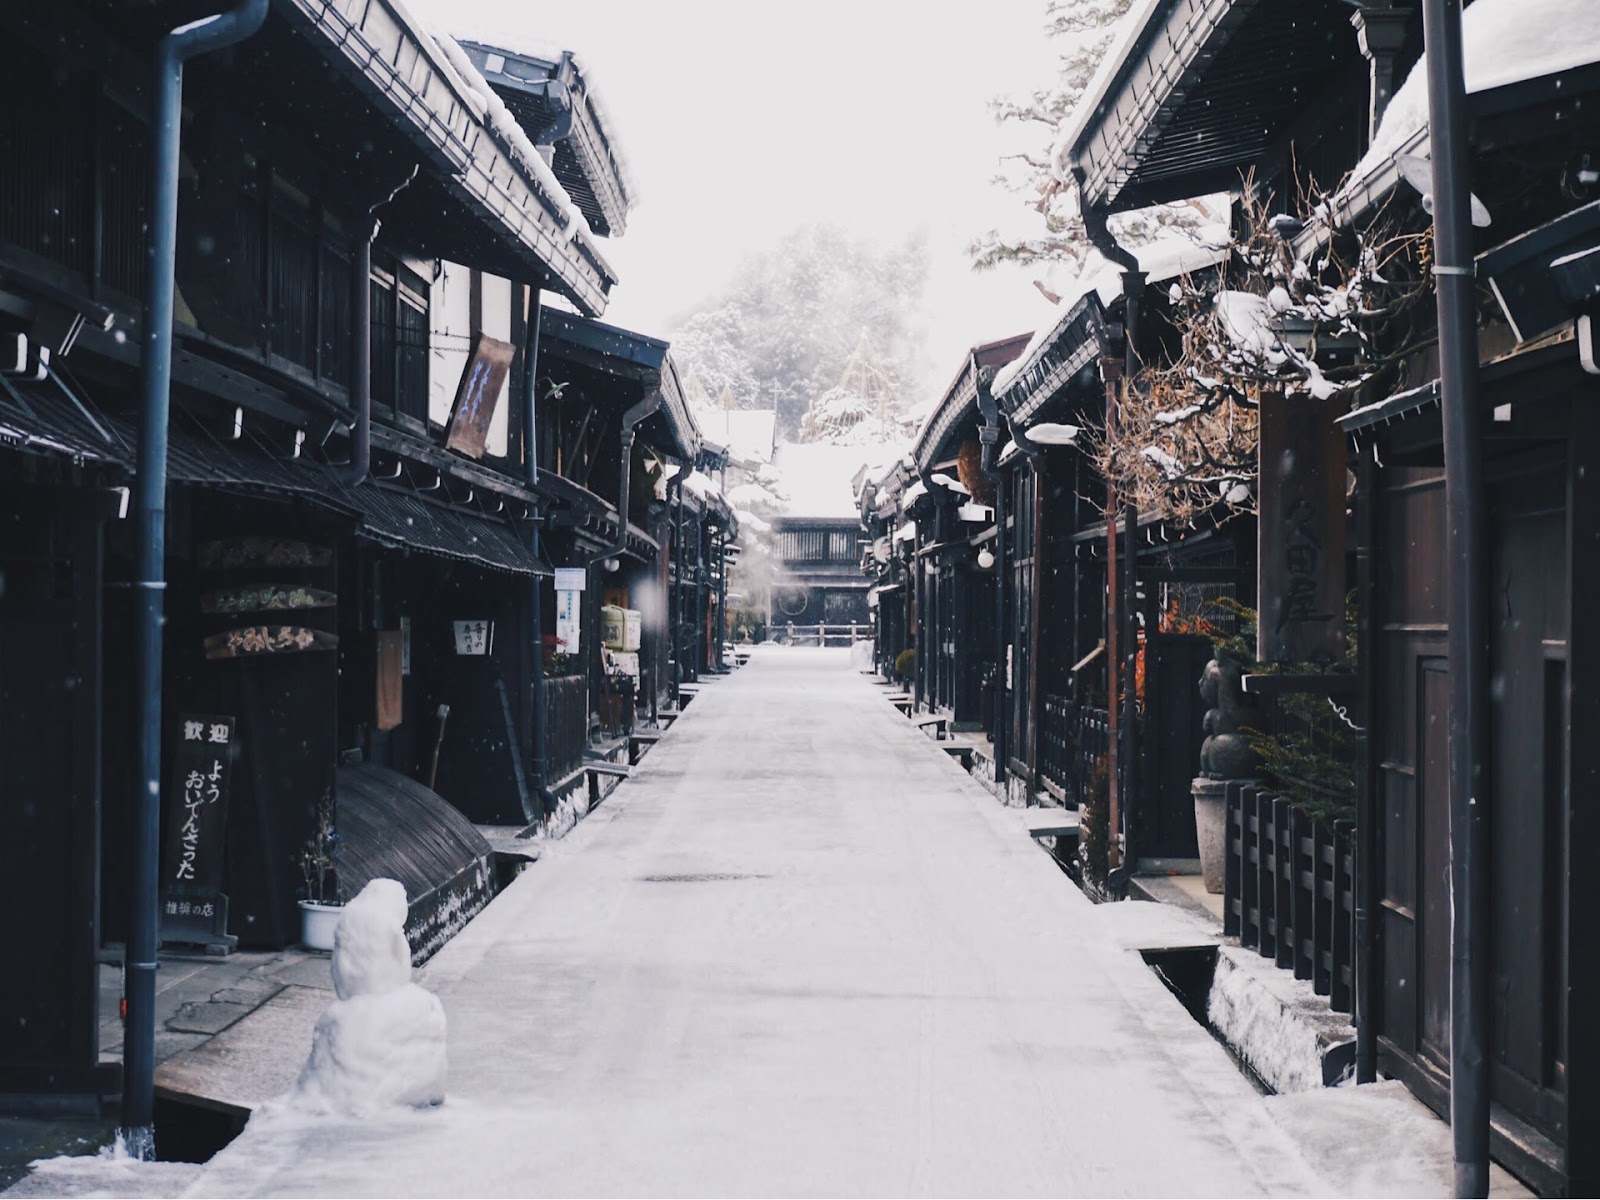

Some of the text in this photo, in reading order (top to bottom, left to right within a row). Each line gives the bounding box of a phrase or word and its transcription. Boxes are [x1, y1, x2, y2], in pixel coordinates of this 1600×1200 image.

[184, 719, 230, 744] 歓迎
[206, 759, 223, 804] よう
[175, 770, 206, 880] おいでんさった
